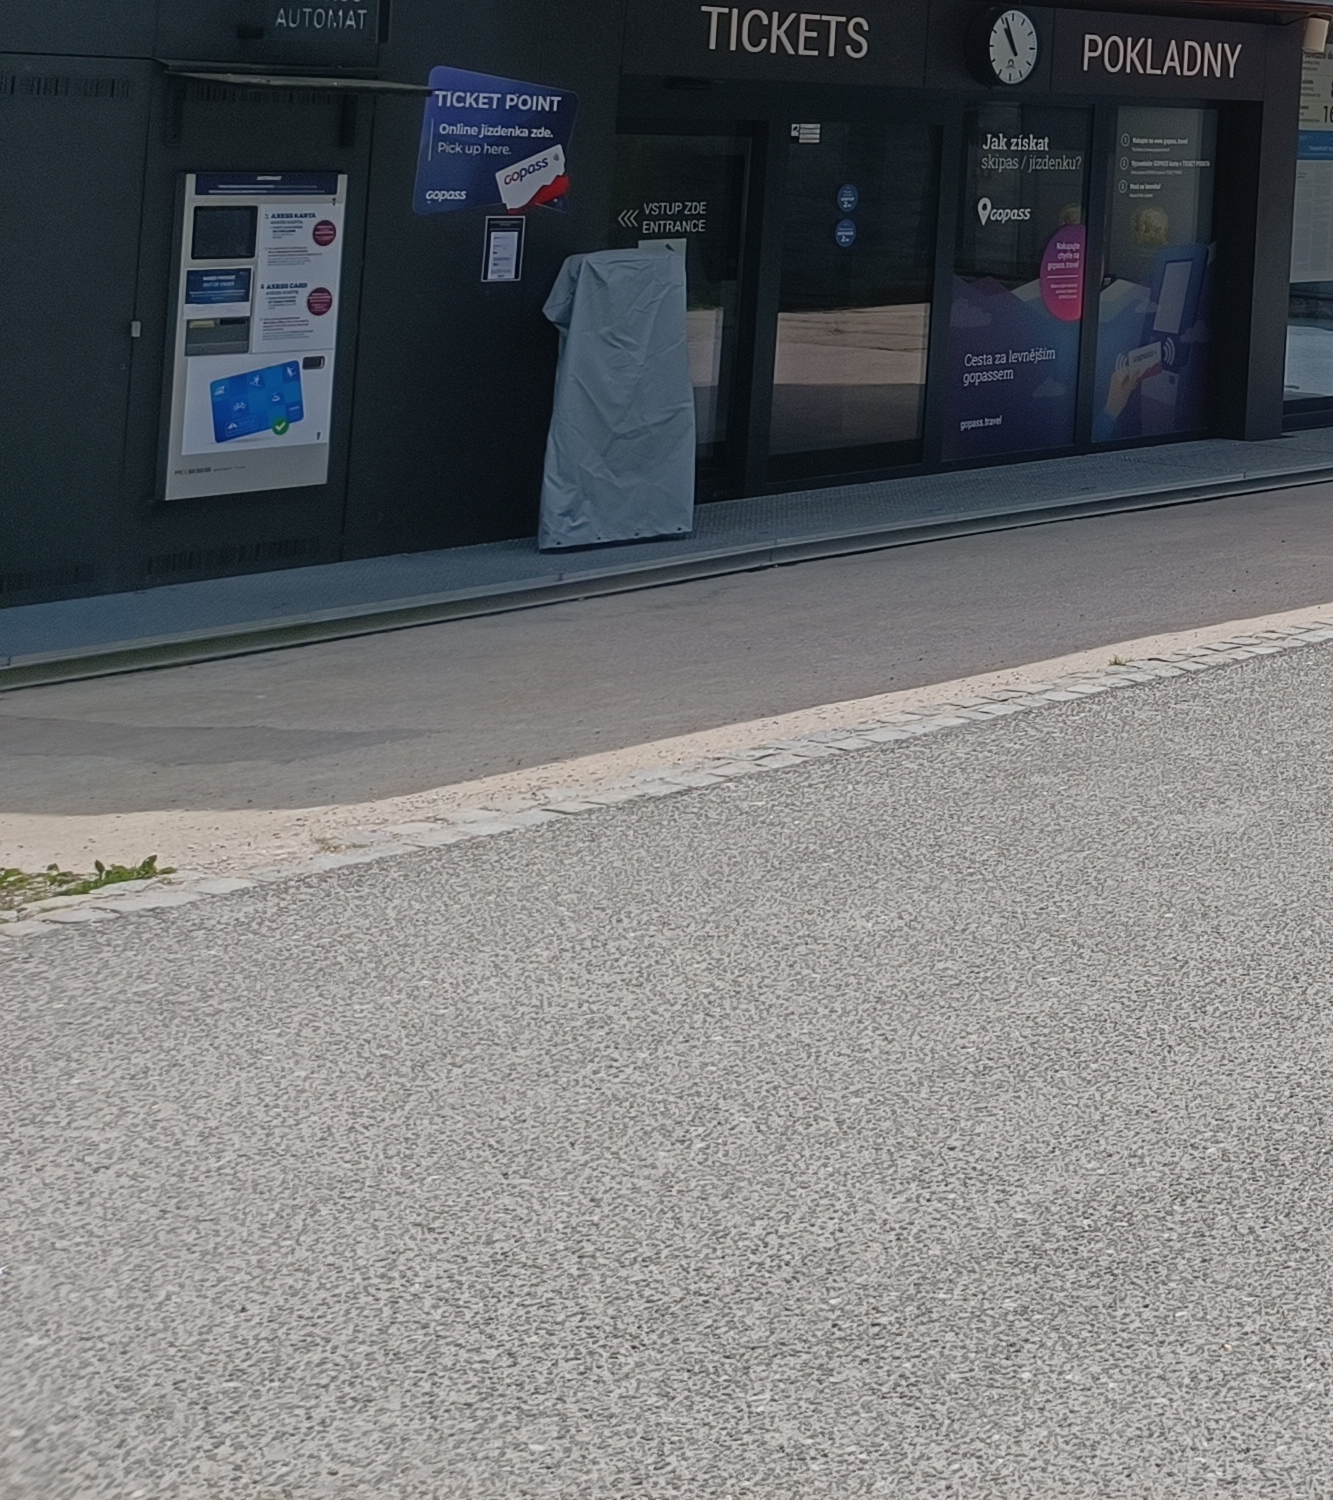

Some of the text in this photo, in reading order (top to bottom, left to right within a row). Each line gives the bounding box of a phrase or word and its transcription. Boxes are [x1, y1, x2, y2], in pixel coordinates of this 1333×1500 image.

[275, 8, 368, 29] AUTOMAT
[701, 5, 869, 59] TICKETS
[1083, 34, 1242, 78] POKLADNY
[433, 91, 562, 112] TICKET POINT
[439, 123, 554, 138] Online jízdenka zde.
[437, 141, 512, 157] Pick up here.
[982, 133, 1049, 151] Jak získat
[981, 154, 1019, 172] skipas
[1027, 154, 1082, 173] jízdenku?
[643, 201, 707, 215] VSTUP ZDE
[642, 219, 706, 233] ENTRANCE
[964, 347, 1055, 367] Cesta za levnějším
[963, 369, 1014, 386] gopassem
